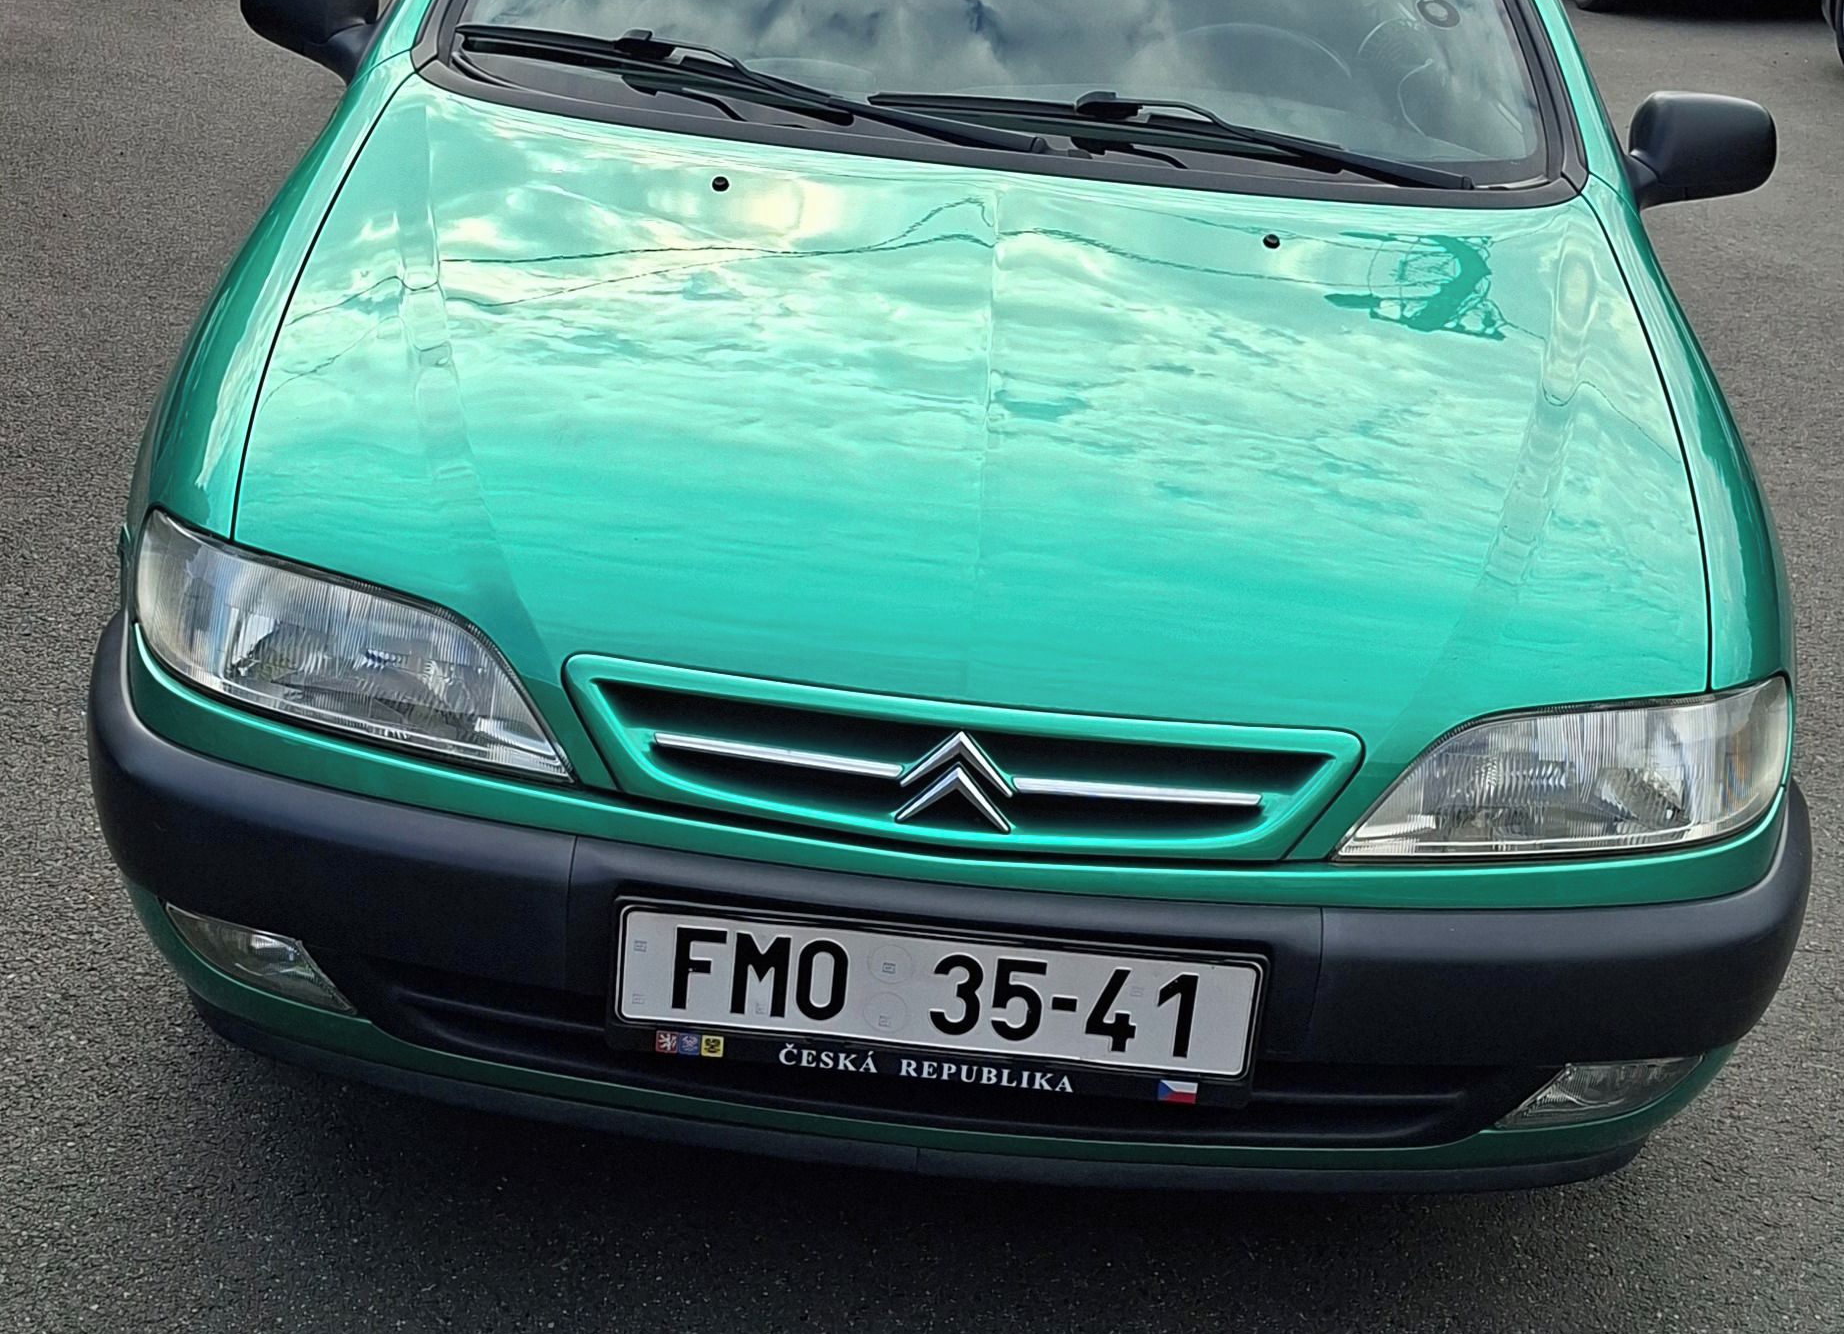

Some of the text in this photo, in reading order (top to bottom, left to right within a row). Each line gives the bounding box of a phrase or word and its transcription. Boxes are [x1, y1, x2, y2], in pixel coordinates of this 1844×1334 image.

[671, 926, 1199, 1058] FMO 35-41
[778, 1043, 1074, 1093] ČESKÁ REPUBLIKA
